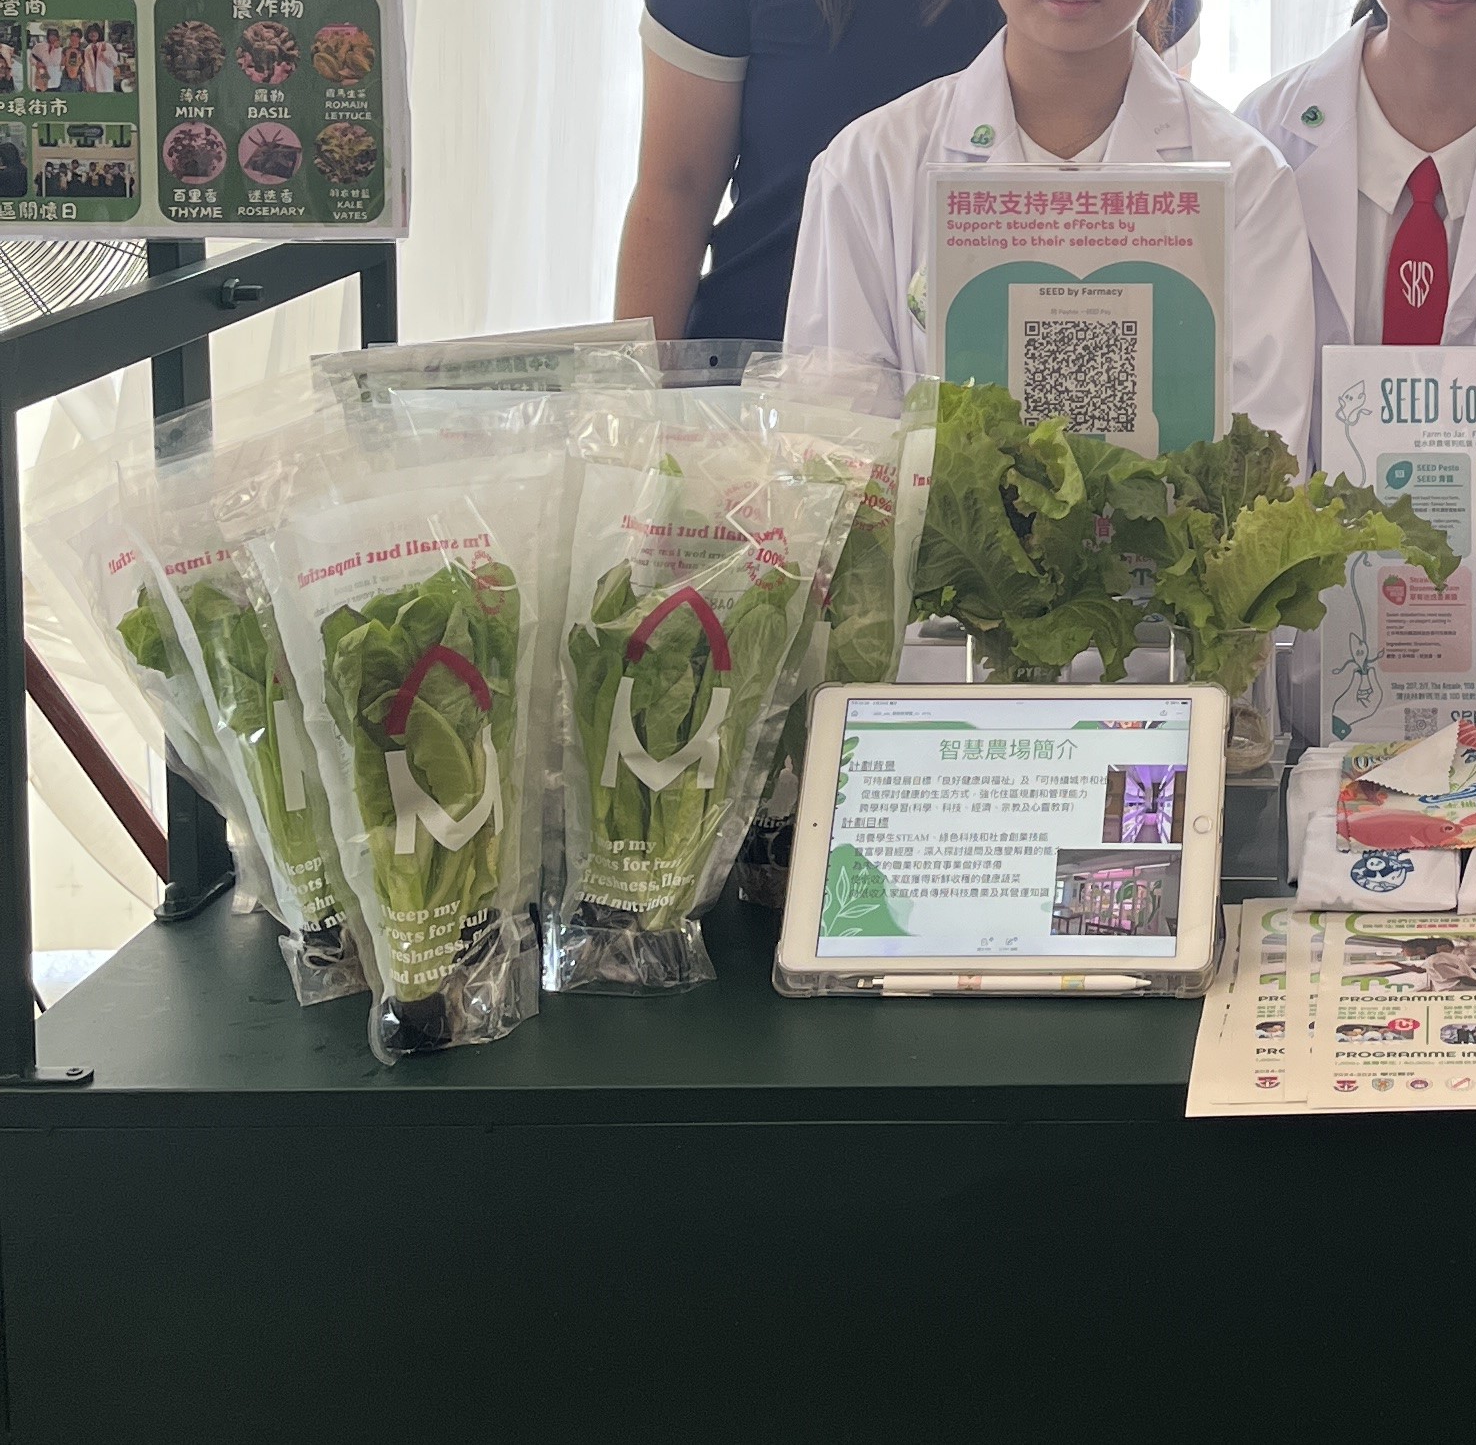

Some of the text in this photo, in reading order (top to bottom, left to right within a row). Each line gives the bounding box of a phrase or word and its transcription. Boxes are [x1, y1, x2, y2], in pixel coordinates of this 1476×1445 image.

[325, 100, 368, 110] ROMAIN
[175, 106, 215, 119] MINT
[248, 106, 291, 119] BASIL
[324, 111, 372, 121] LETTUCE
[337, 200, 363, 209] KALE
[947, 191, 1201, 215] 捐款支持學生種植成果
[169, 206, 223, 219] THYME
[237, 206, 305, 217] ROSEMARY
[333, 210, 368, 221] VATES
[947, 219, 1135, 232] Support student efforts by
[946, 235, 1193, 249] donating to their selected charities
[1400, 260, 1434, 308] SKS
[1039, 287, 1123, 298] SEED by Farmacy
[1380, 377, 1439, 424] SEED
[1422, 430, 1441, 438] Farm
[940, 738, 1078, 761] 智慧農場簡介
[628, 839, 656, 853] my
[623, 857, 650, 872] for
[388, 899, 461, 924] keep my
[428, 921, 456, 940] for
[458, 908, 489, 930] full
[1339, 994, 1455, 1002] PROGRAMME
